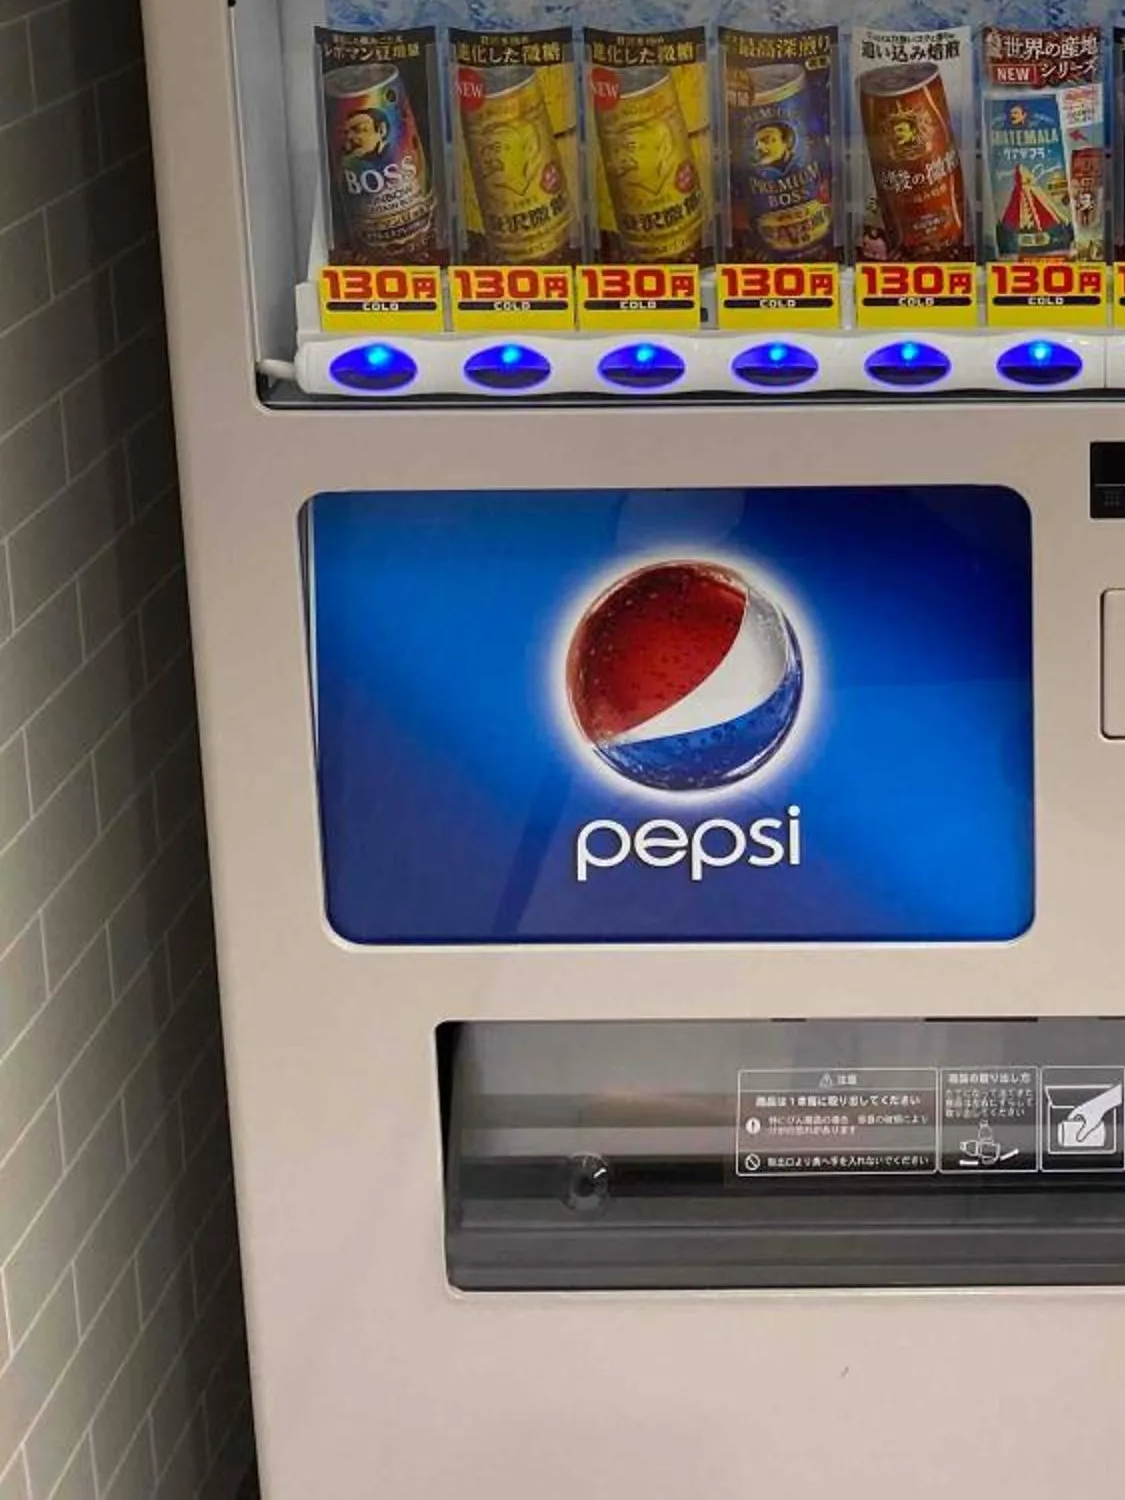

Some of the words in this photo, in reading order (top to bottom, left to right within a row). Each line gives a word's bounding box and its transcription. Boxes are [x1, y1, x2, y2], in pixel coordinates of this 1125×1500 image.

[1004, 34, 1098, 60] 世界の産地
[997, 67, 1030, 82] NEW
[1040, 59, 1097, 78] シリーズ
[345, 155, 417, 195] BOSS
[323, 269, 437, 300] 130円
[453, 269, 568, 300] 130円
[581, 268, 695, 299] 130円
[722, 267, 833, 296] 130円
[862, 266, 972, 296] 130円
[992, 265, 1102, 295] 130円
[362, 302, 399, 311] COLD
[493, 302, 531, 310] COLD
[620, 300, 657, 309] COLD
[759, 298, 796, 308] COLD
[898, 297, 935, 307] COLD
[1028, 296, 1065, 306] COLD
[577, 805, 801, 882] pepsi
